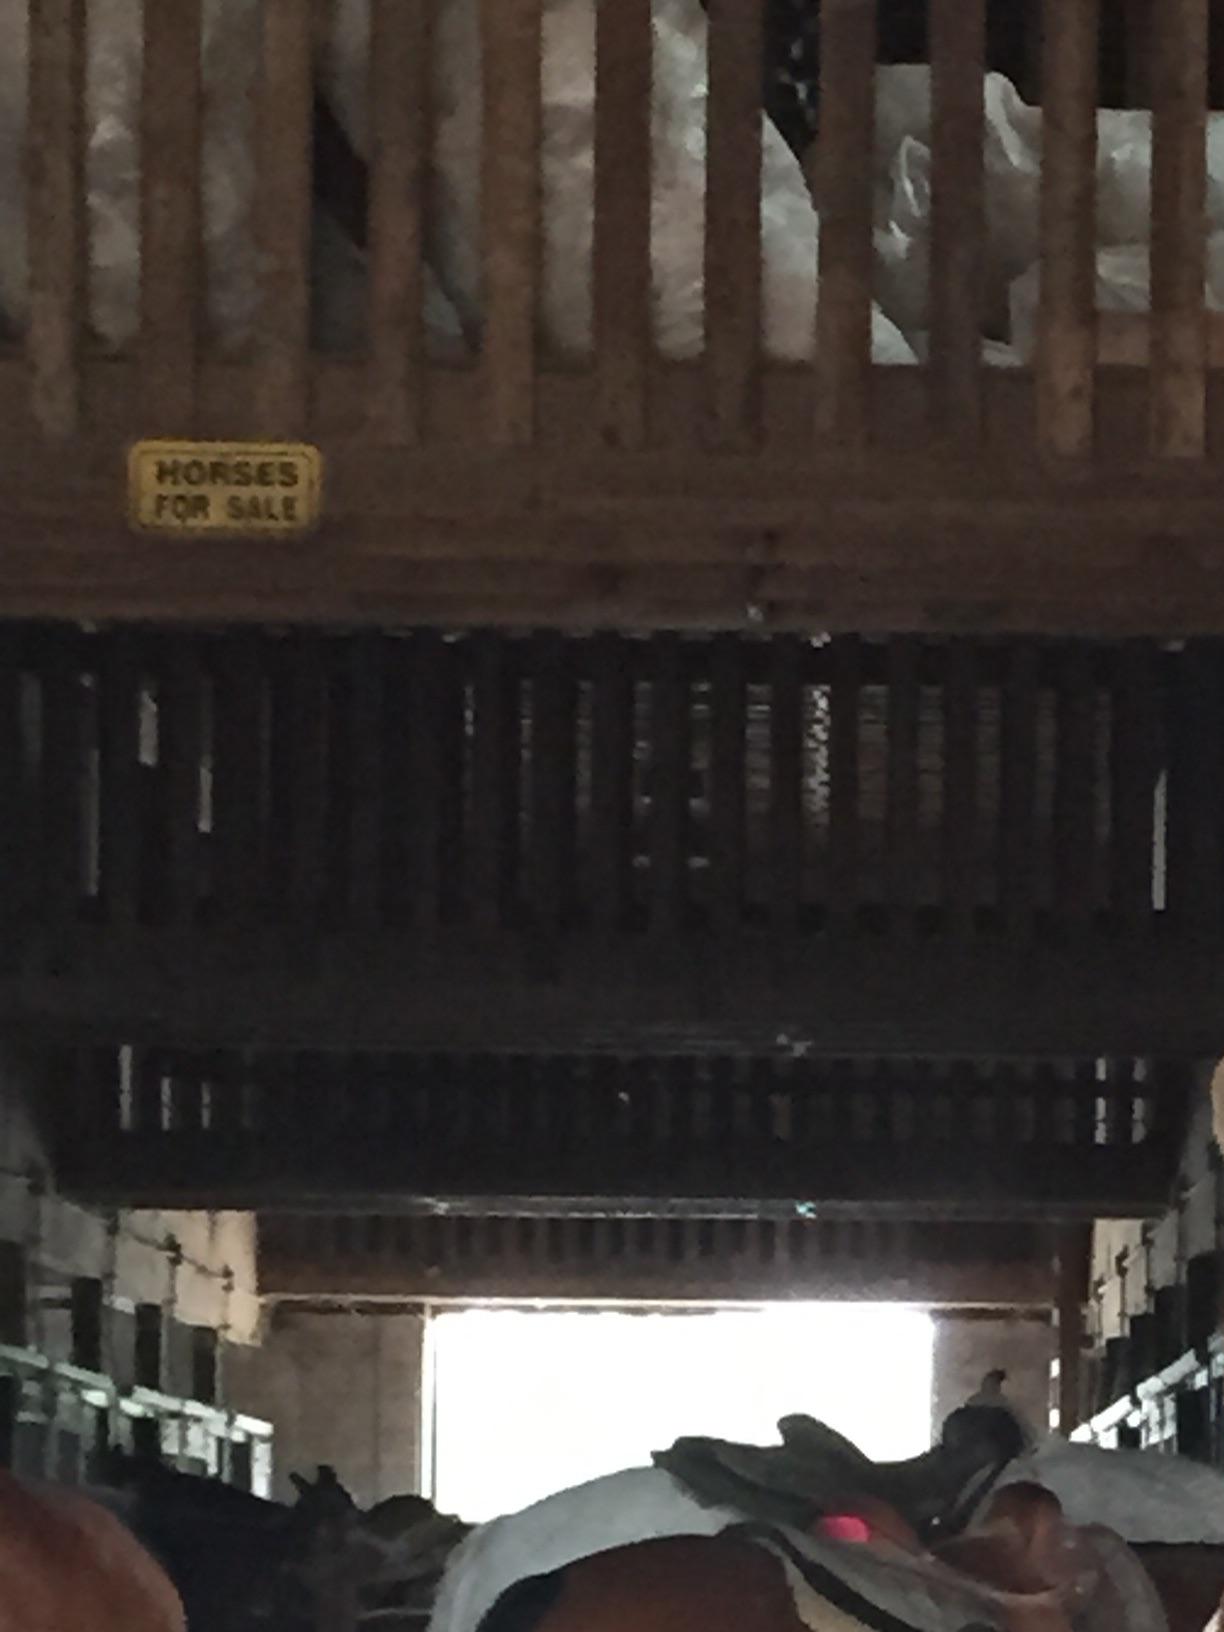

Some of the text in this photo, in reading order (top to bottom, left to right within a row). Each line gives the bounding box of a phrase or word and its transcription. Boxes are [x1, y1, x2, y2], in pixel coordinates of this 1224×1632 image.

[155, 460, 298, 487] HORSES
[155, 493, 297, 521] FOR SALE
